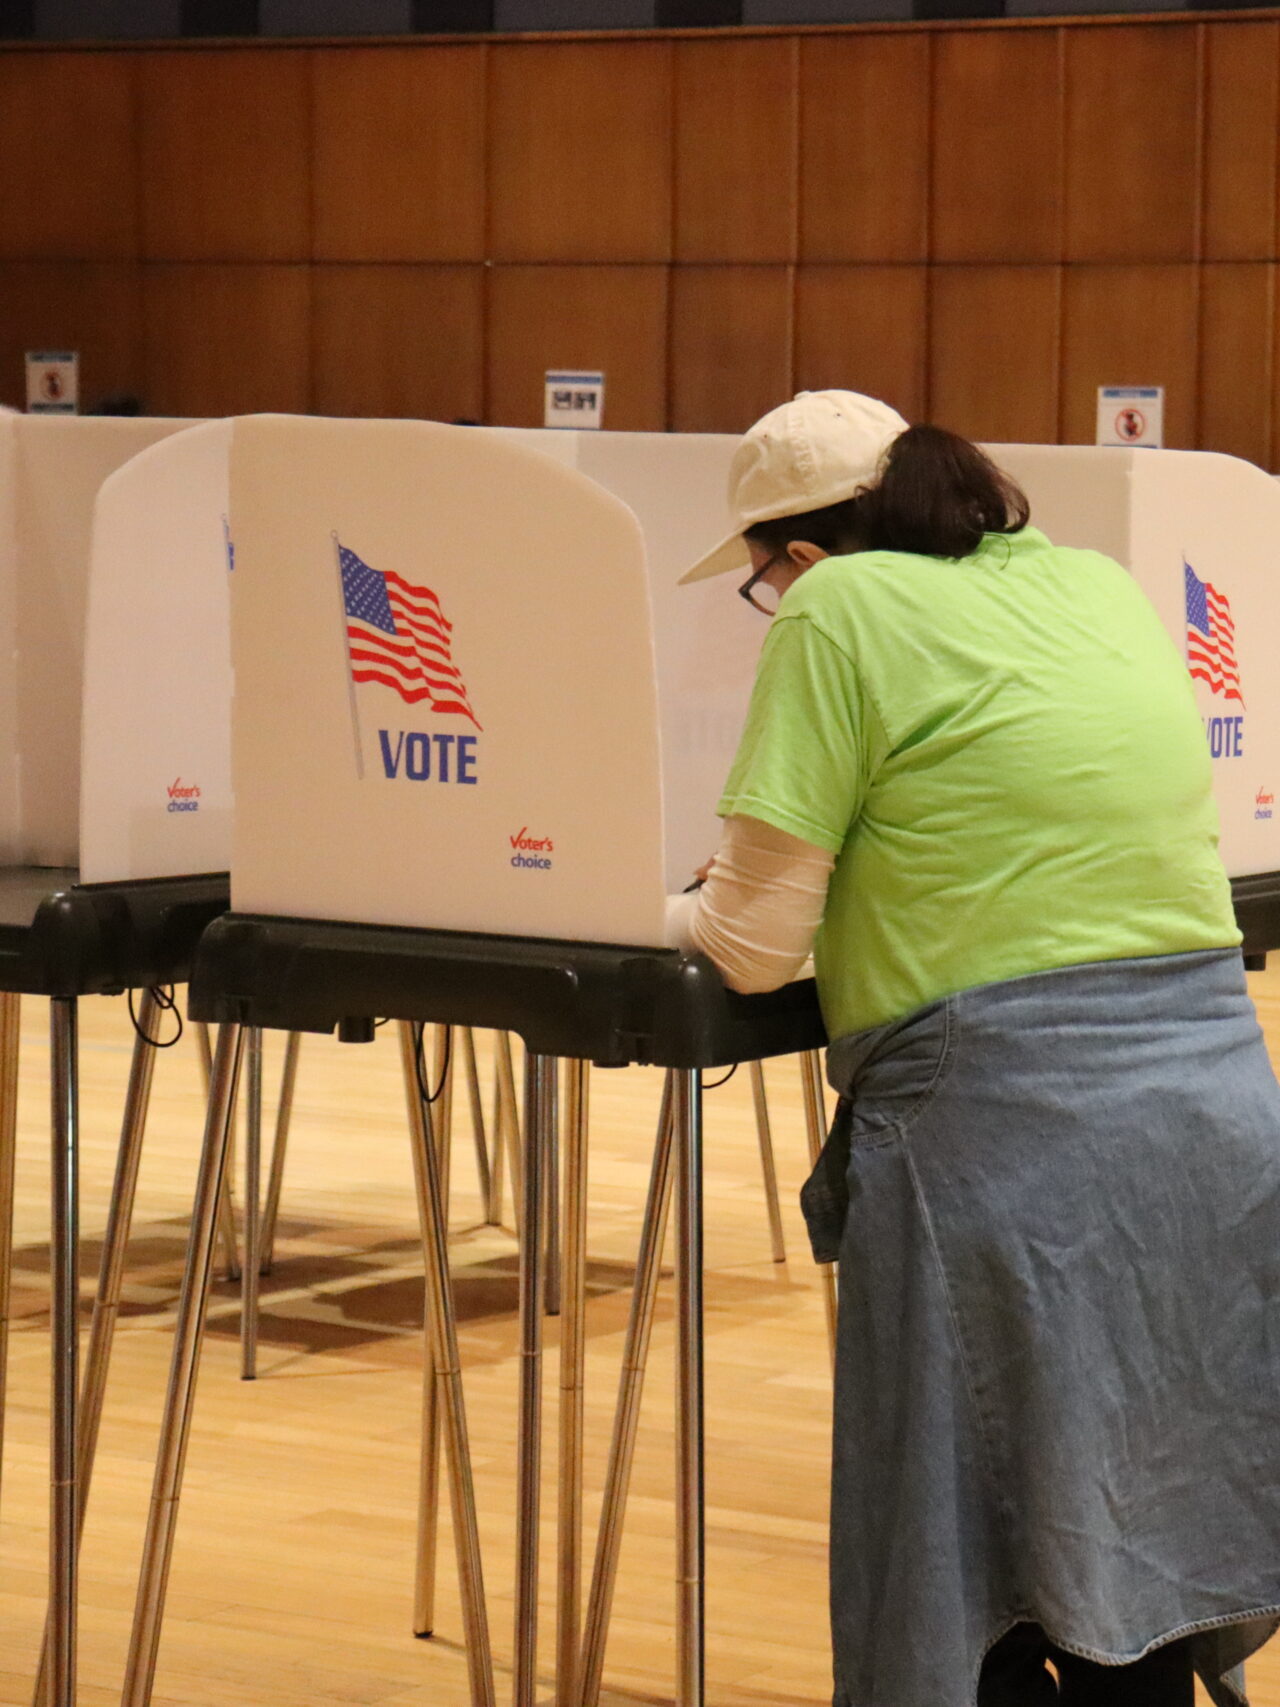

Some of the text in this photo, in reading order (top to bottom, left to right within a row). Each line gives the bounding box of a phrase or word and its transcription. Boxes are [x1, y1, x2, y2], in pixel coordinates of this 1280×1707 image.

[378, 730, 477, 784] VOTE
[510, 826, 554, 852] Voter's
[511, 853, 552, 870] choice
